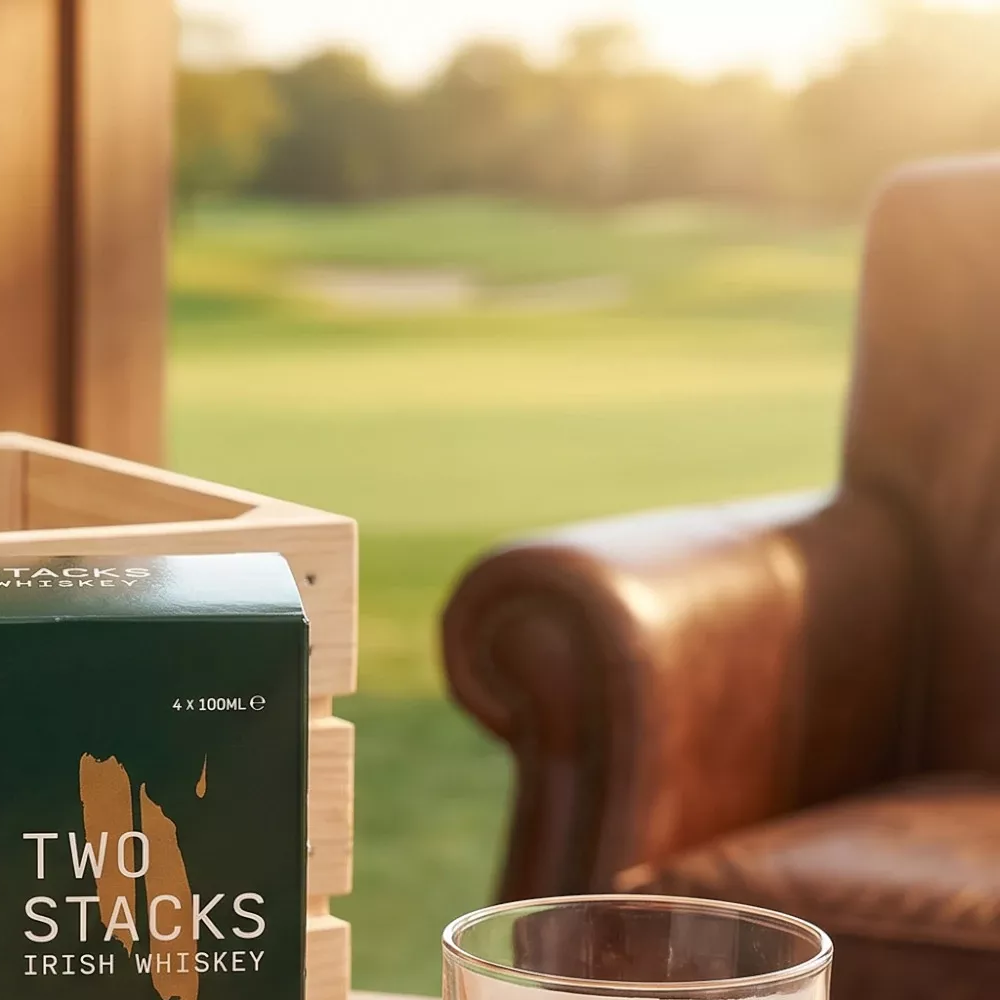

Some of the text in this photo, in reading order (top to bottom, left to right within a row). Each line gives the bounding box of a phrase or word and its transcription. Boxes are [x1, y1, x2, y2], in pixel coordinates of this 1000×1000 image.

[172, 698, 182, 711] 4
[22, 831, 150, 880] TWO
[24, 892, 266, 943] STACKS
[24, 951, 265, 975] IRISH WHISKEY
